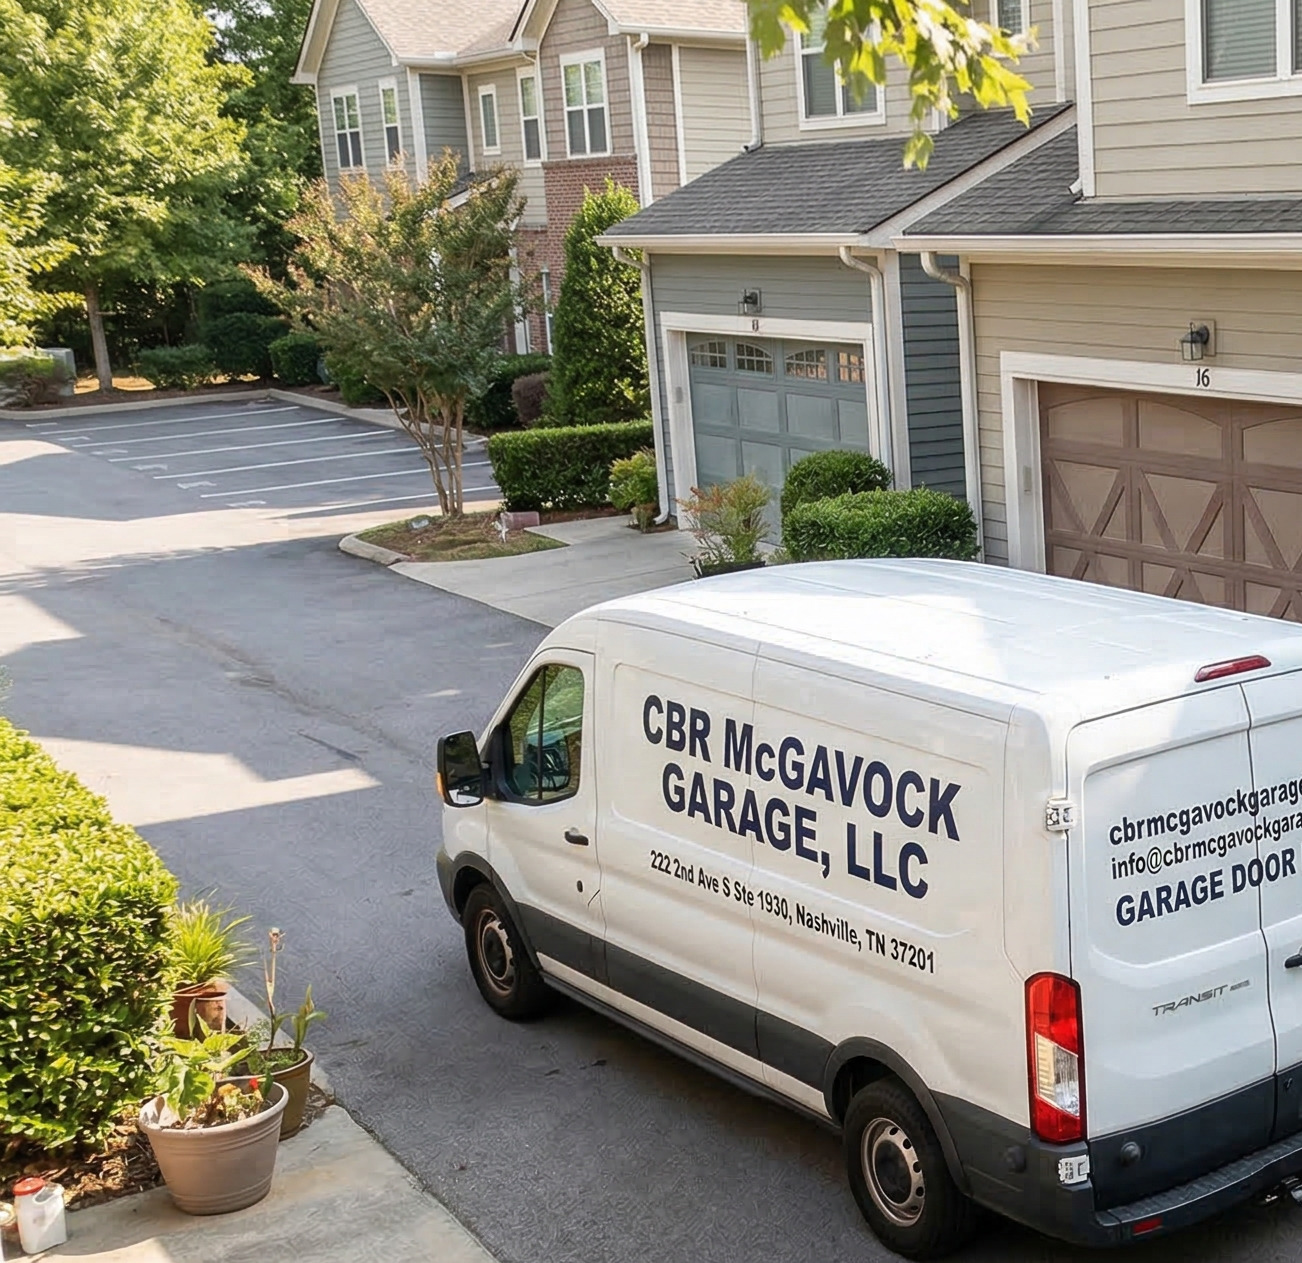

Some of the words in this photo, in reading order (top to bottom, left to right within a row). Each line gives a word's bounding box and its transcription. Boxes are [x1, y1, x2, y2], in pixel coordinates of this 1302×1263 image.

[1196, 368, 1210, 387] 16
[643, 694, 712, 763] CBR
[723, 718, 962, 842] McGAVOCK
[662, 762, 831, 879] GARAGE,
[846, 822, 929, 900] LLC
[650, 850, 672, 875] 222
[673, 858, 695, 884] 2nd
[698, 868, 719, 894] Ave
[722, 876, 731, 898] S
[733, 880, 755, 907] Ste
[757, 890, 793, 926] 1930,
[795, 902, 862, 952] Nashville,
[865, 928, 886, 957] TN
[890, 938, 935, 974] 37201
[1116, 868, 1225, 927] GARAGE
[1231, 847, 1297, 894] DOOR
[1152, 984, 1229, 1017] TRANSIT
